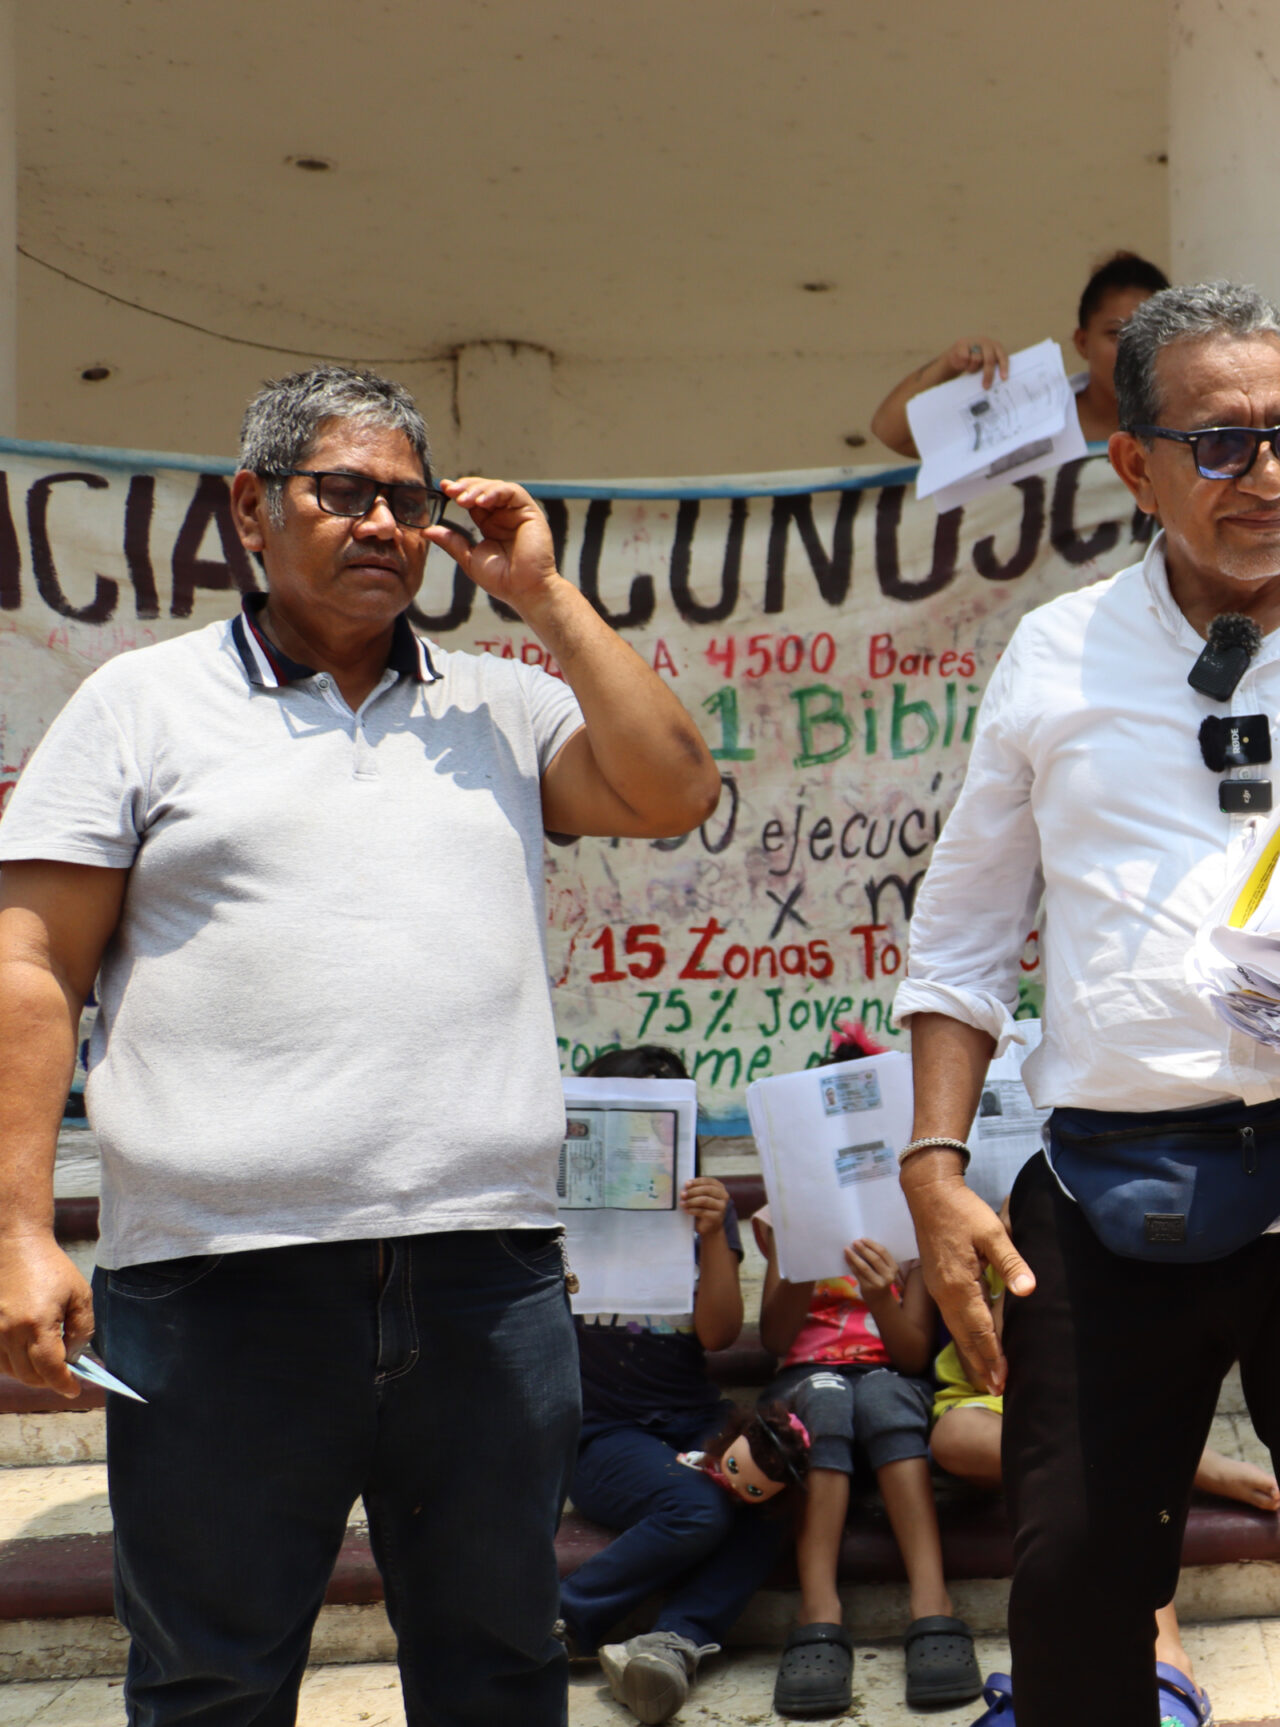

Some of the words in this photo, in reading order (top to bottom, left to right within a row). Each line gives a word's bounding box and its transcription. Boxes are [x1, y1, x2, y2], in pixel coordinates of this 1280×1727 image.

[704, 632, 836, 679] 4500
[869, 633, 977, 679] Bares
[702, 684, 756, 762] 1
[790, 682, 981, 769] Bibli
[762, 771, 942, 877] ejecuci
[864, 870, 927, 936] m
[590, 923, 665, 984] 15
[678, 917, 834, 980] Zonas
[850, 924, 908, 980] To
[637, 988, 738, 1040] 75%
[759, 982, 902, 1036] Jóvene
